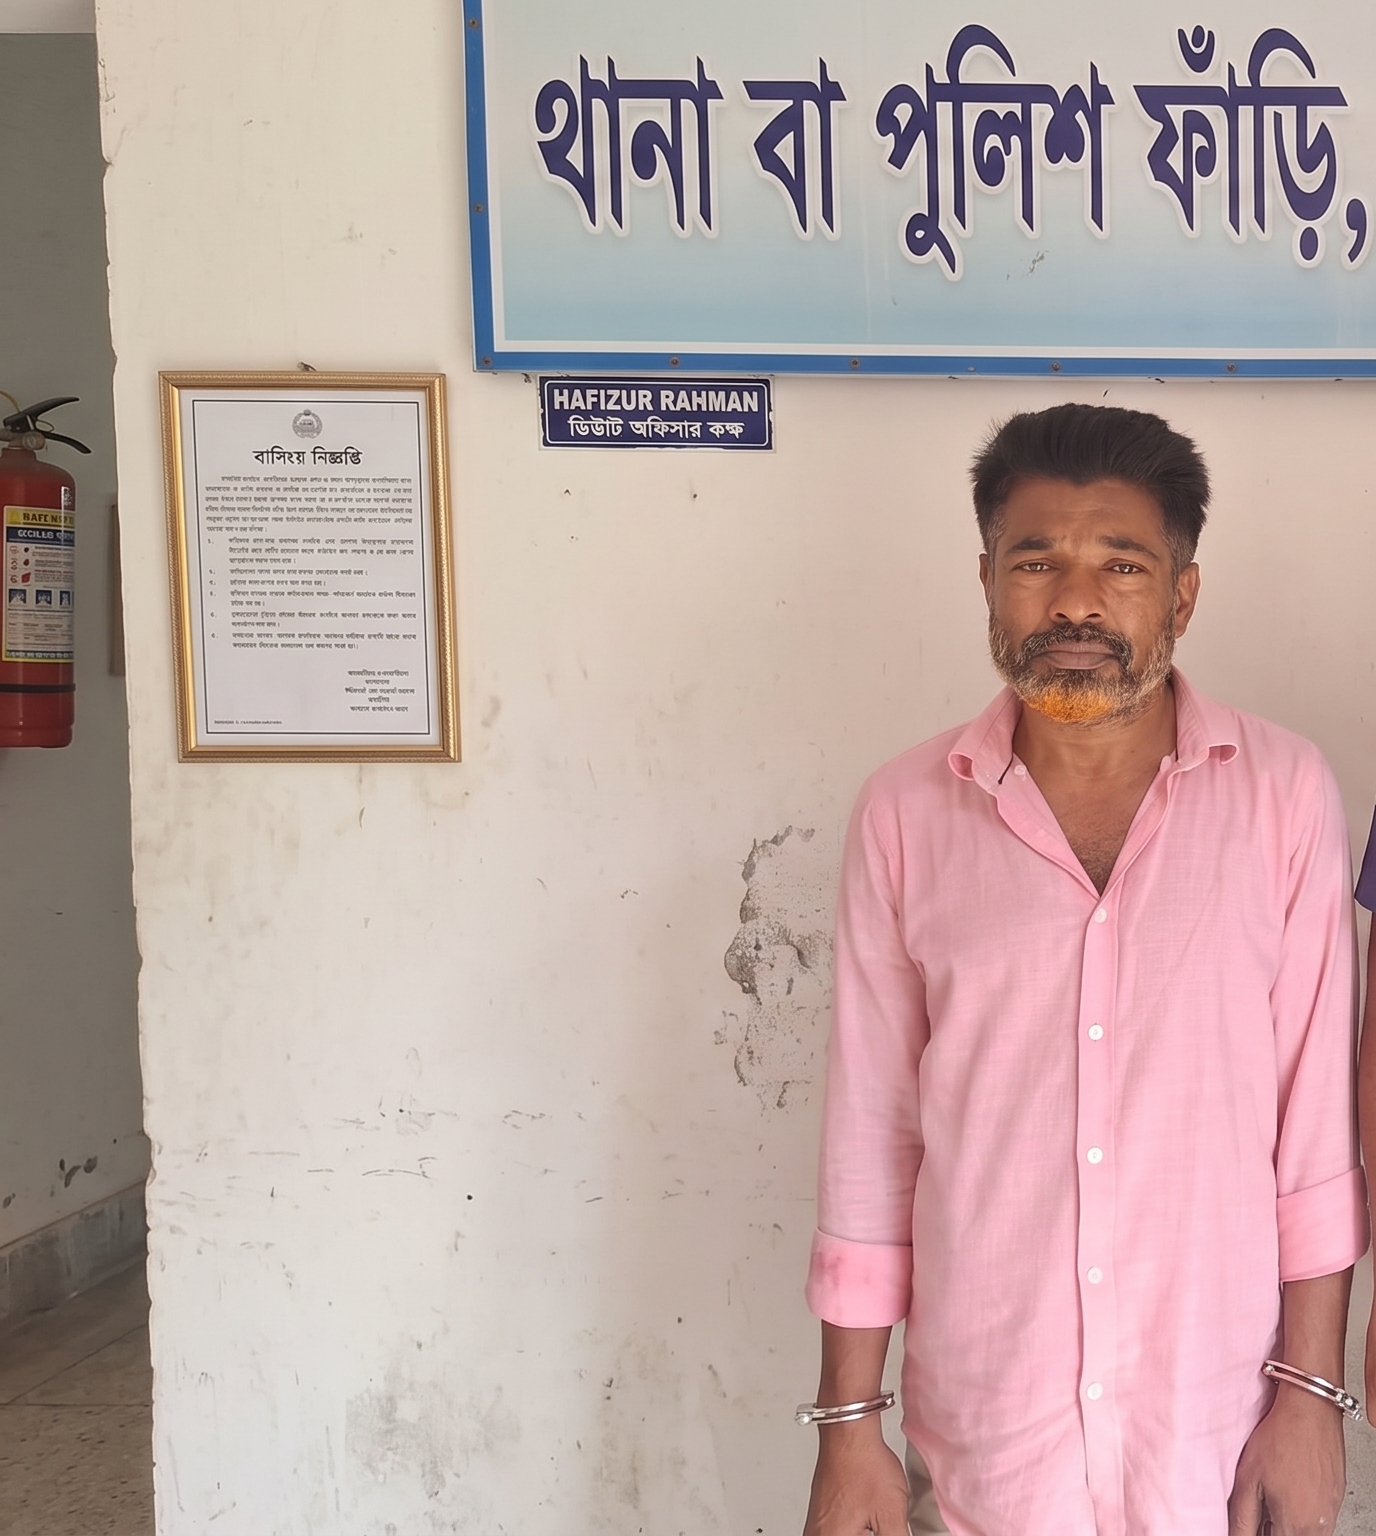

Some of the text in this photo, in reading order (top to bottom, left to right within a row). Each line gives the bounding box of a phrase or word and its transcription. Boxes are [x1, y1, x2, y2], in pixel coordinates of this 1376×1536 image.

[535, 54, 724, 231] থানা
[742, 57, 847, 234] বা
[875, 24, 1116, 274] পুলিশ
[1133, 24, 1367, 264] ফাঁড়ি,
[553, 388, 759, 412] HAFIZUR RAHMAN
[628, 415, 702, 439] অফিসার
